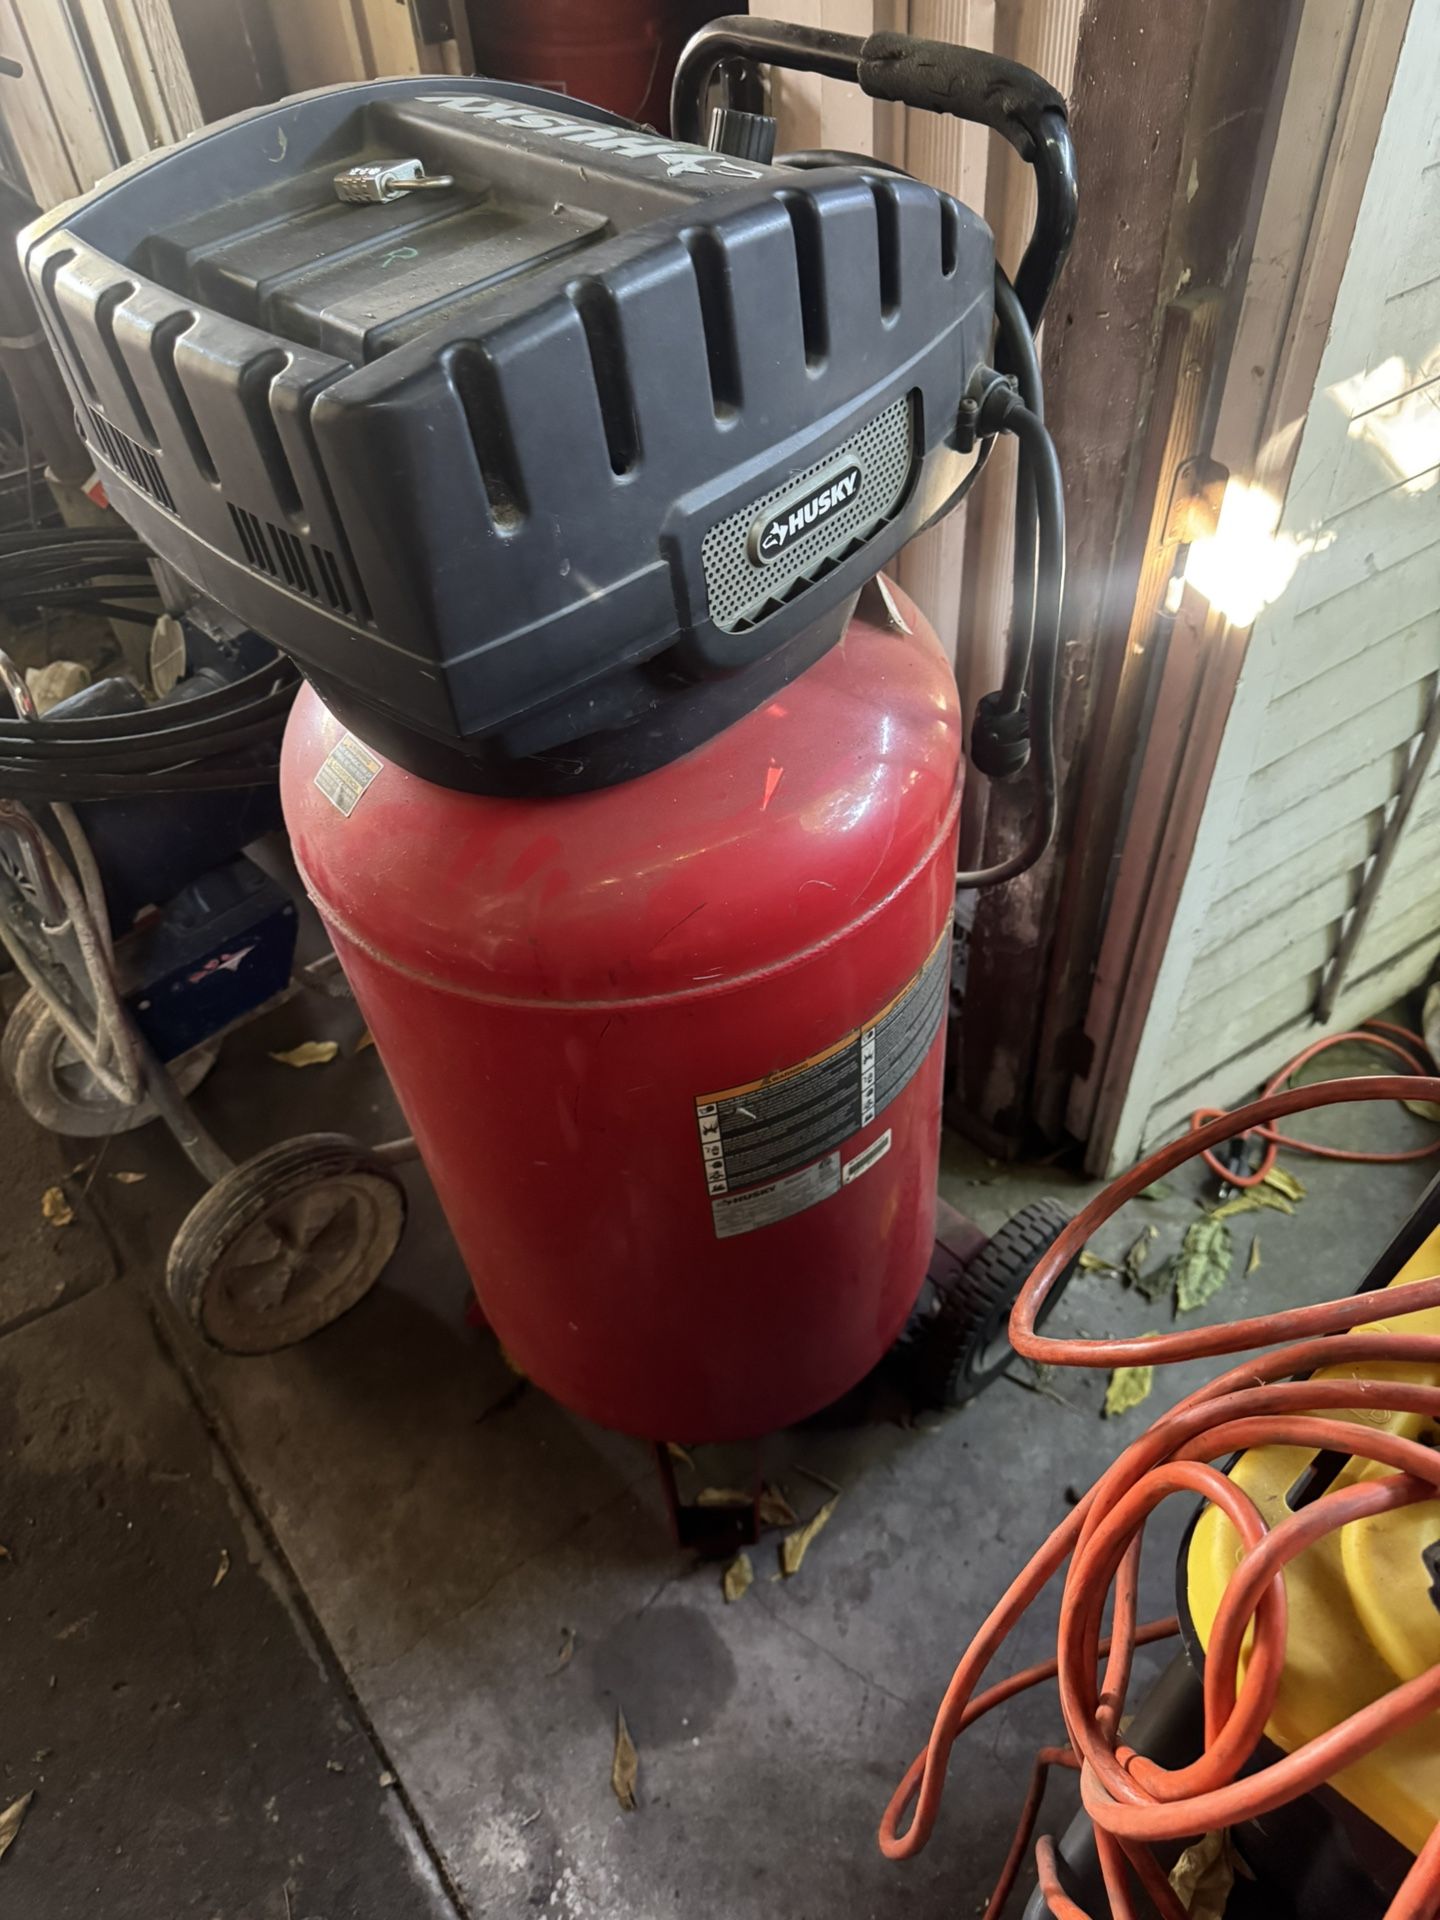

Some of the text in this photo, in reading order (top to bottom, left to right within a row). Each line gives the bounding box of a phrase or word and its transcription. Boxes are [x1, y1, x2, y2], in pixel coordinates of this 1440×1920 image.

[415, 96, 680, 159] HUSKY
[788, 471, 857, 536] HUSKY
[733, 1184, 776, 1204] HUSKY
